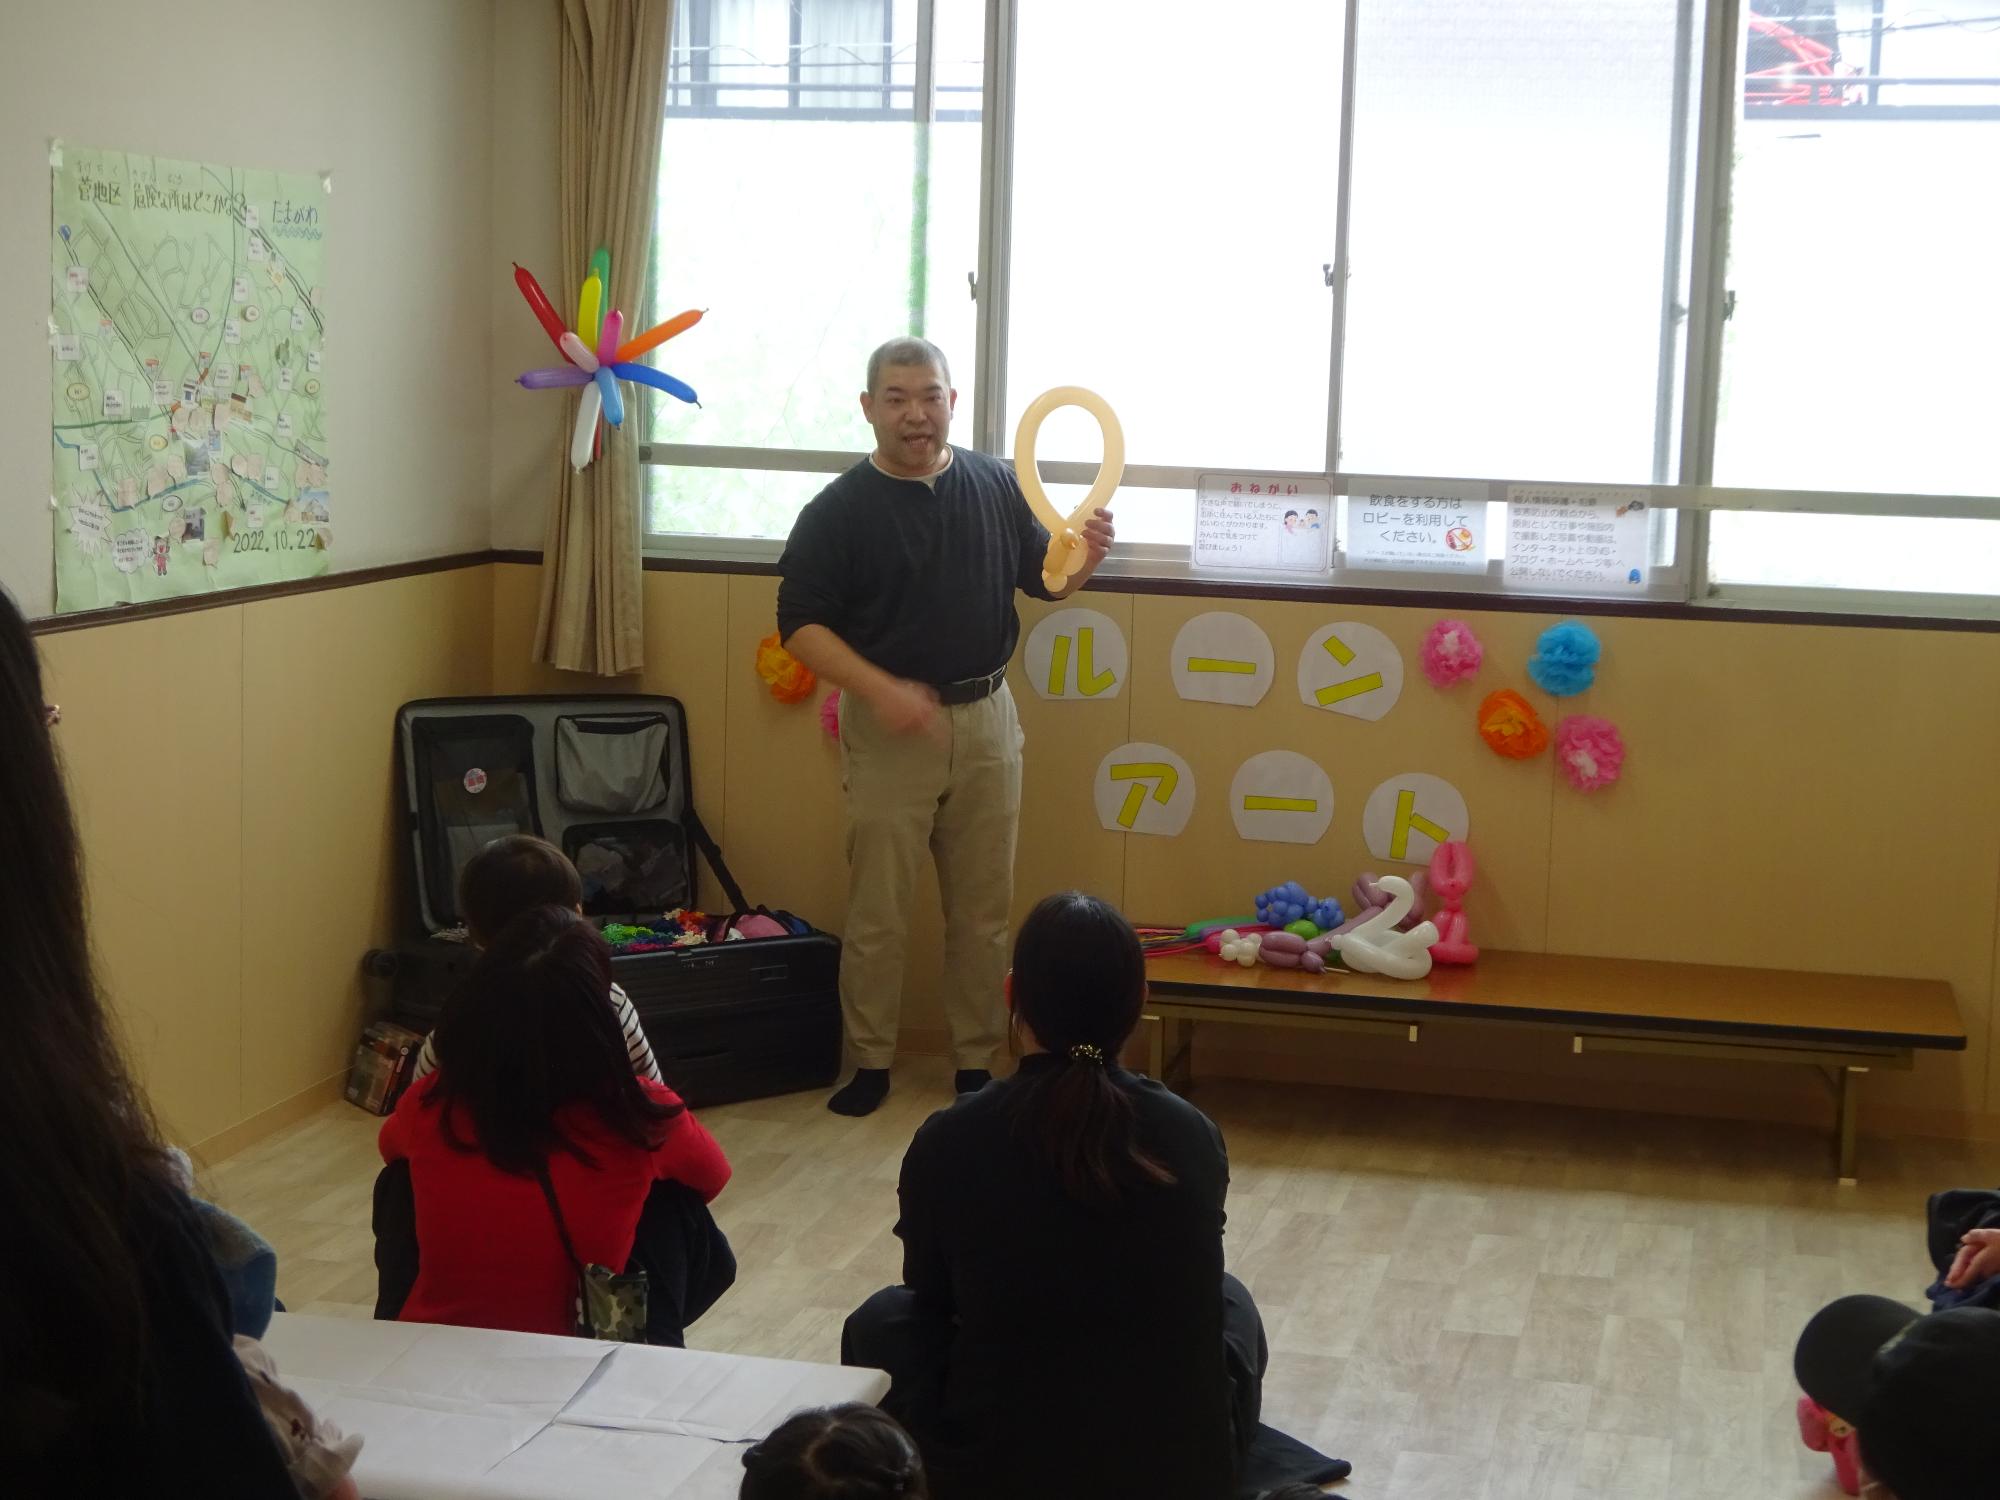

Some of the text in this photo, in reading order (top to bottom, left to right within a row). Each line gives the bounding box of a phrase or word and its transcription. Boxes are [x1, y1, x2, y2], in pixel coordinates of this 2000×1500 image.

[1230, 482, 1298, 494] おねがい
[1369, 494, 1463, 509] 飲食をする方は
[1362, 511, 1469, 527] ロビーを利用して
[233, 527, 316, 553] 2022.10.22
[1379, 530, 1438, 544] ください。
